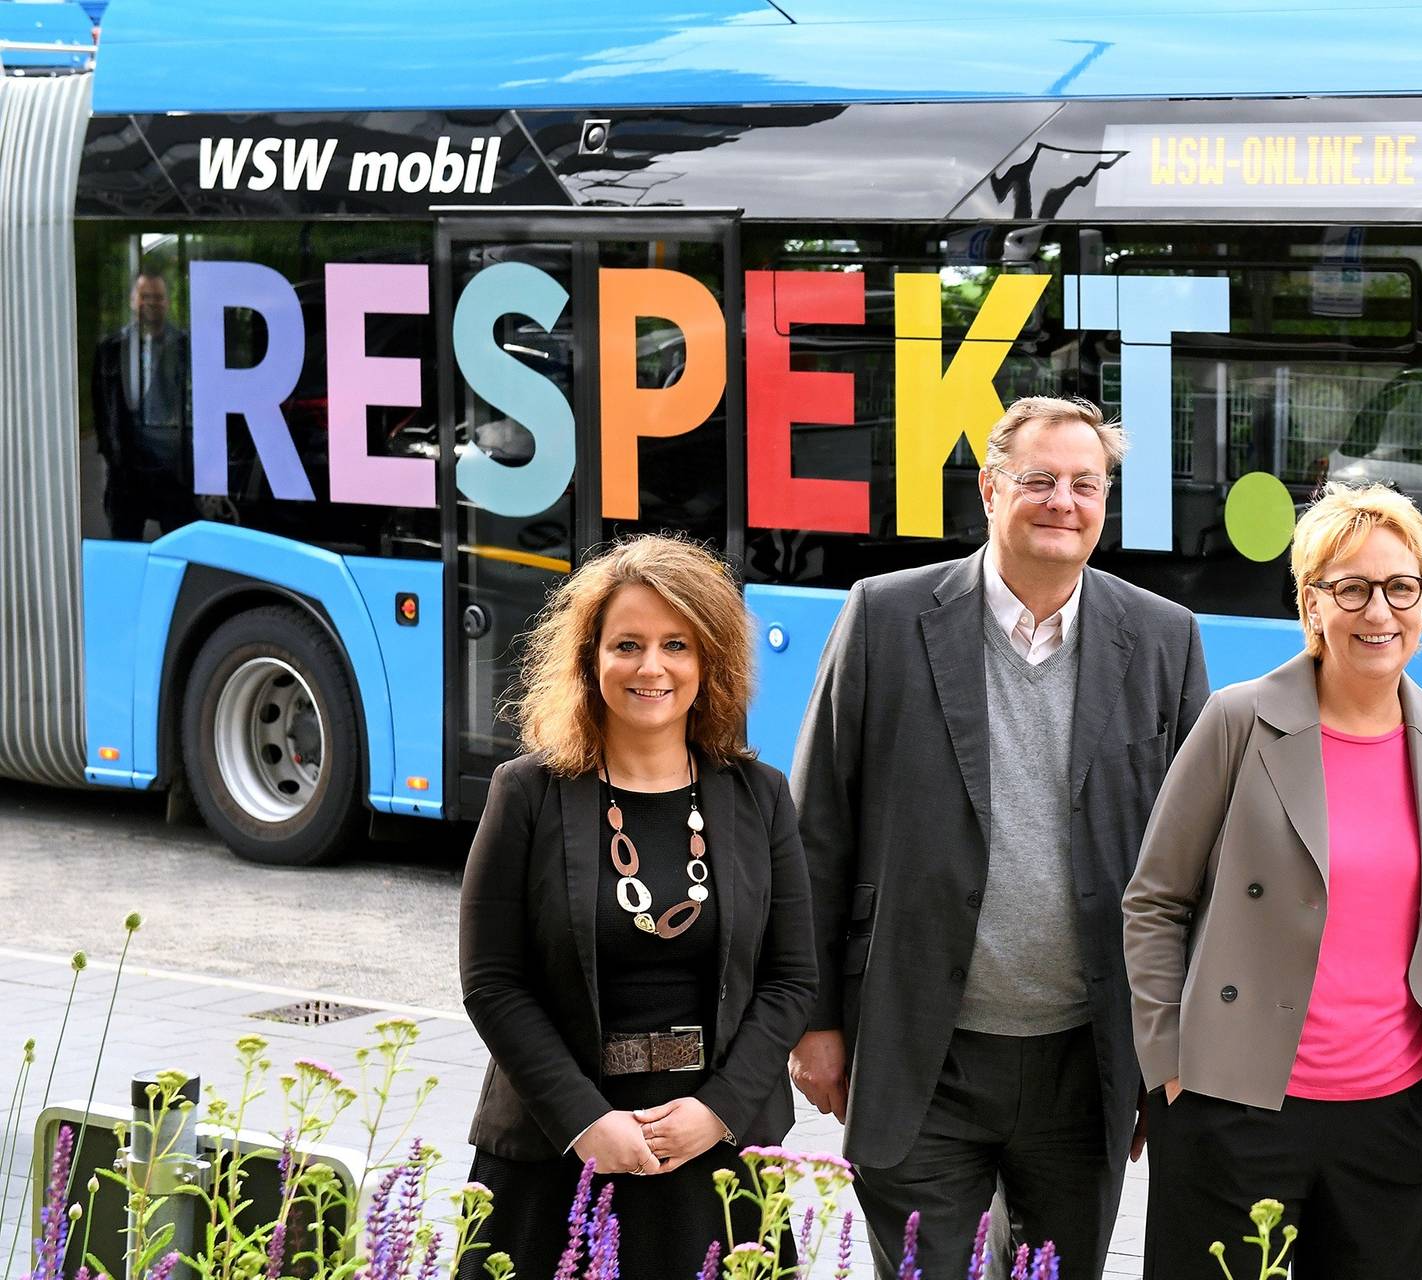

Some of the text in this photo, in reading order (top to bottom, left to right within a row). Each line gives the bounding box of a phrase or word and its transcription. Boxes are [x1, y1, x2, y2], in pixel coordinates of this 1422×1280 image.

[199, 136, 501, 193] WSW mobil
[1149, 135, 1417, 186] WSW-ONLINE.DE
